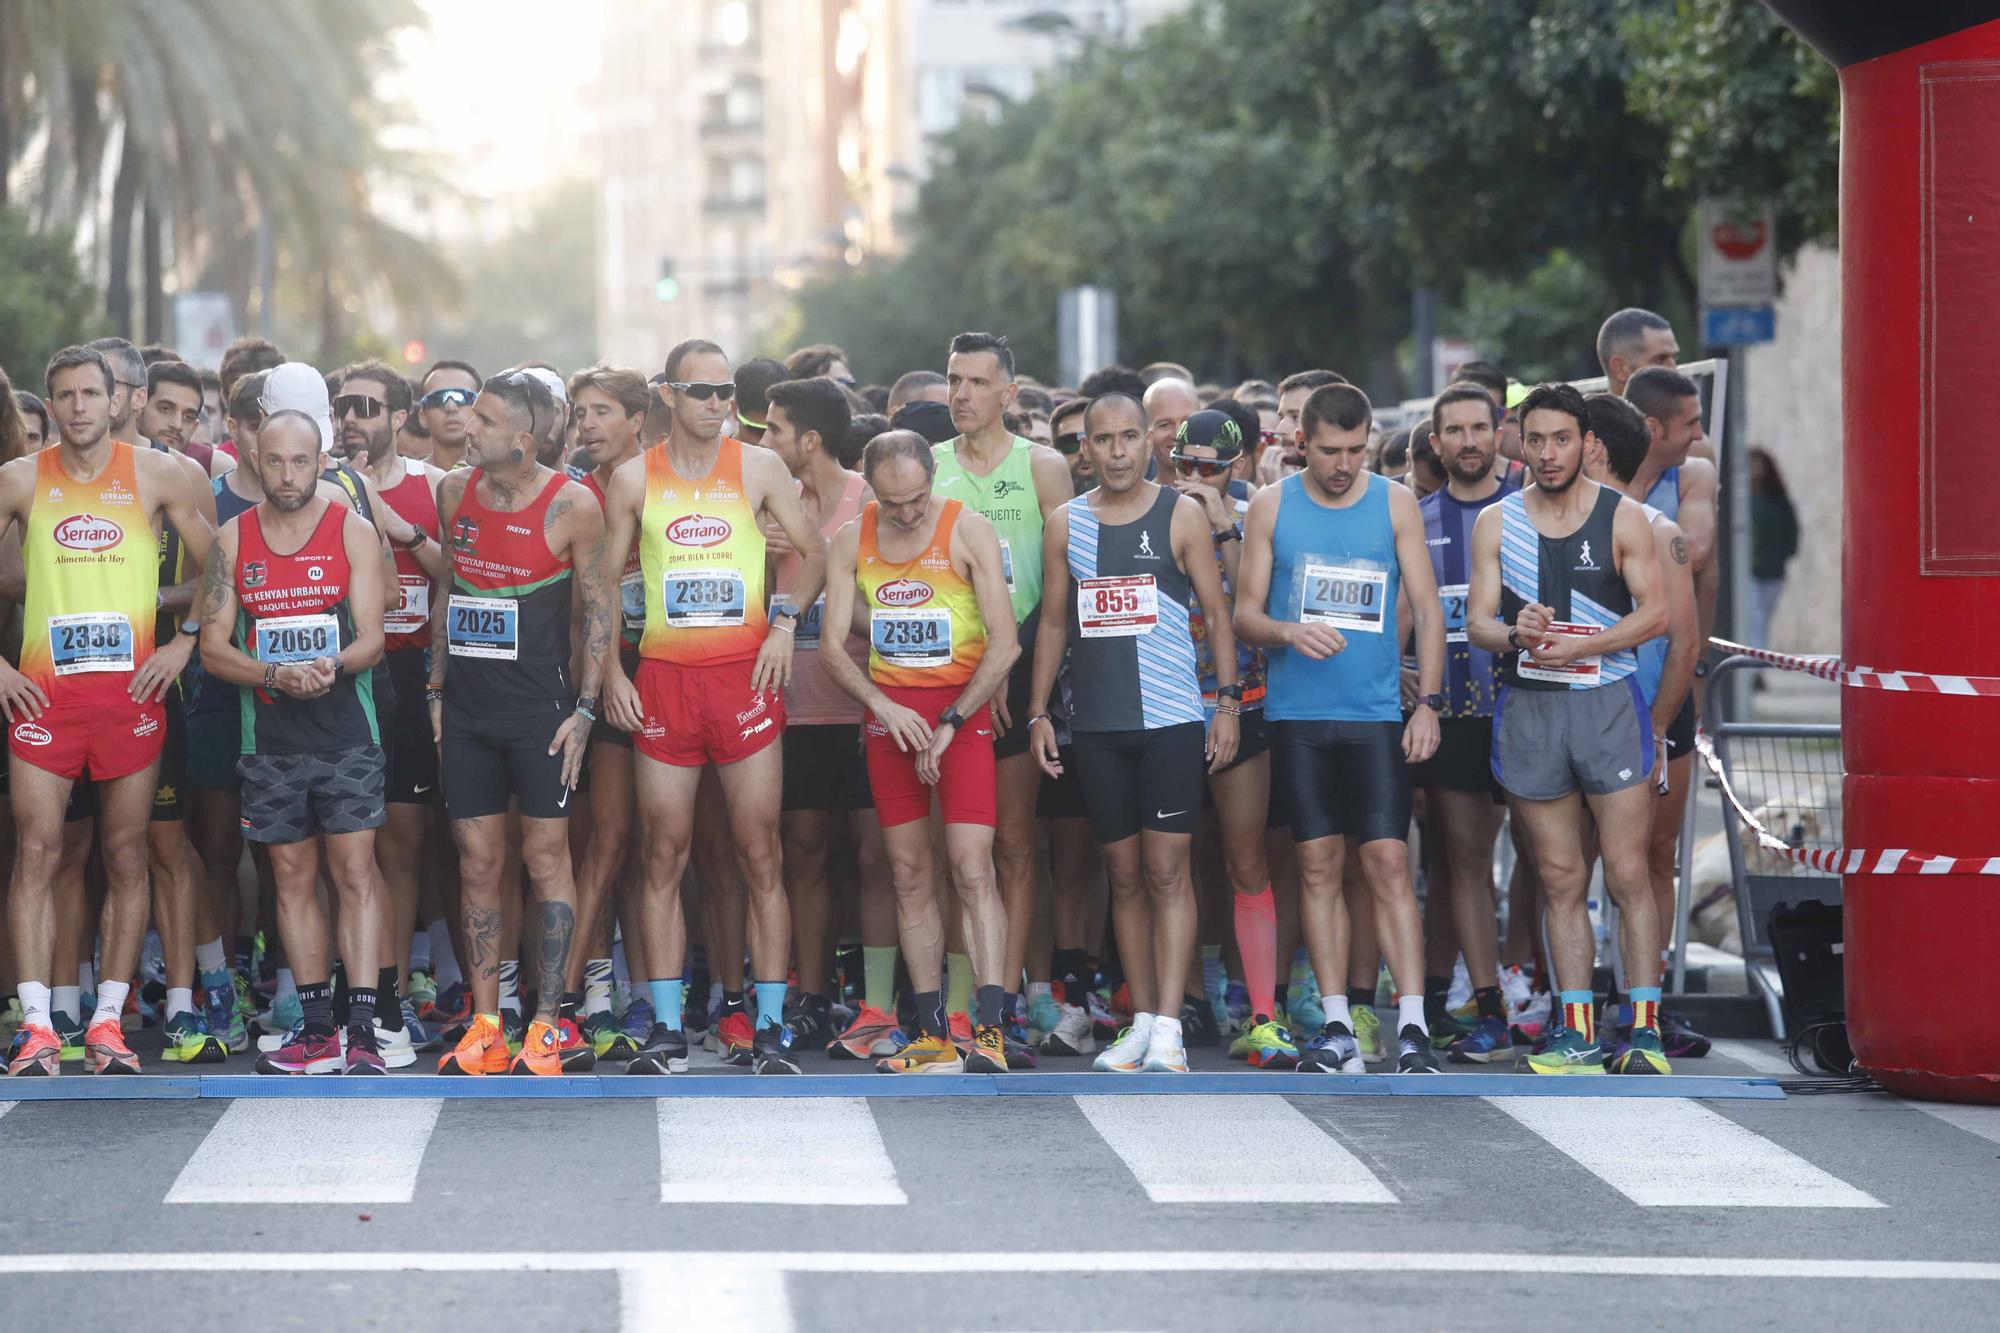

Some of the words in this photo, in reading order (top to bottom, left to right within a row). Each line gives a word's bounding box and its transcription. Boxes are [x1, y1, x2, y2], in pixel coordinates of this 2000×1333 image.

[100, 493, 134, 501] SERRANO
[61, 526, 118, 542] Serrano
[506, 525, 532, 536] FASTER
[673, 524, 726, 540] Serrano
[54, 555, 96, 564] Alimentos
[98, 554, 107, 563] de
[109, 555, 126, 565] Hoy
[688, 553, 704, 561] BIEN
[712, 552, 734, 560] CORRE
[485, 562, 512, 573] URBAN
[512, 567, 533, 577] WAY
[254, 589, 288, 601] KENYAN
[290, 586, 320, 598] URBAN
[322, 585, 340, 595] WAY
[676, 580, 733, 604] 2339
[882, 587, 929, 600] Serrano
[1315, 578, 1374, 607] 2080
[258, 603, 290, 612] RAQUEL
[1095, 588, 1138, 613] 855
[457, 608, 505, 635] 2025
[62, 624, 120, 650] 2338
[268, 627, 326, 654] 2060
[883, 621, 938, 644] 2334
[738, 703, 765, 722] Paterna
[17, 728, 49, 741] Serrano
[133, 720, 158, 734] SERRANO
